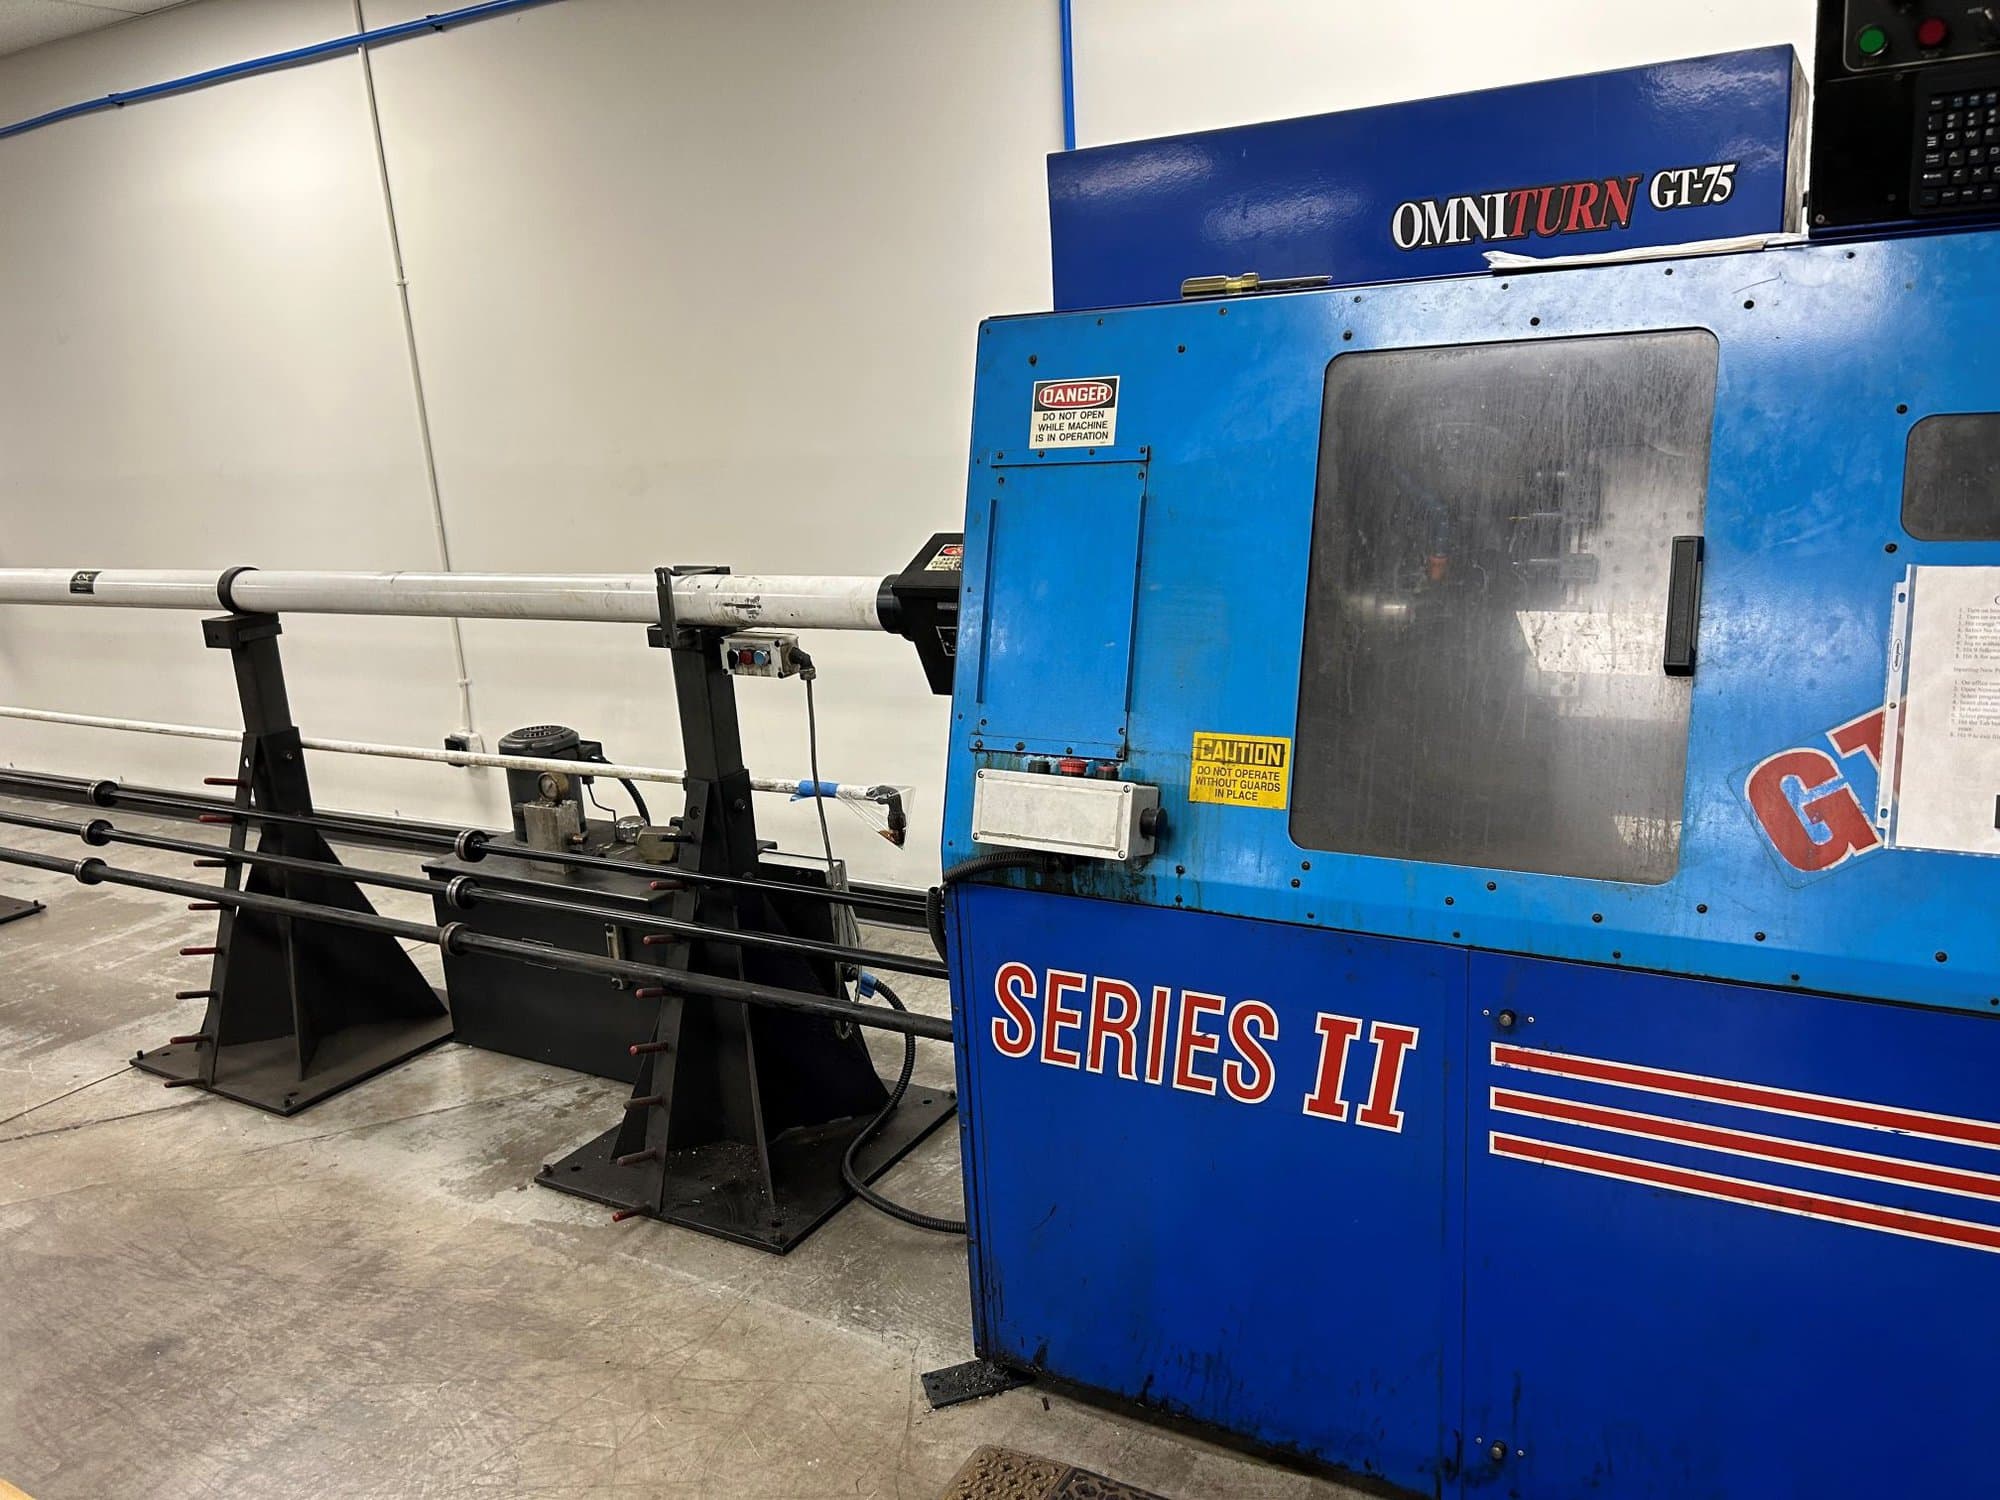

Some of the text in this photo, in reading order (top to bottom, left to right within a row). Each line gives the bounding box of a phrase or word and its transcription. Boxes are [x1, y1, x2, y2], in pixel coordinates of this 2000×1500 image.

[1391, 163, 1739, 250] OMNITURN GT-75
[1043, 385, 1108, 404] DANGER
[1042, 410, 1105, 421] DO NOT OPEN
[1038, 421, 1108, 432] WHILE MACHINE
[1035, 432, 1109, 442] IS IN OPERATION
[1199, 739, 1282, 766] CAUTION
[1197, 766, 1280, 781] DO NOT OPERATE
[1196, 776, 1280, 792] WITHOUT GUARDS
[1215, 789, 1258, 801] IN PLACE
[991, 961, 1420, 1134] SERIES II
